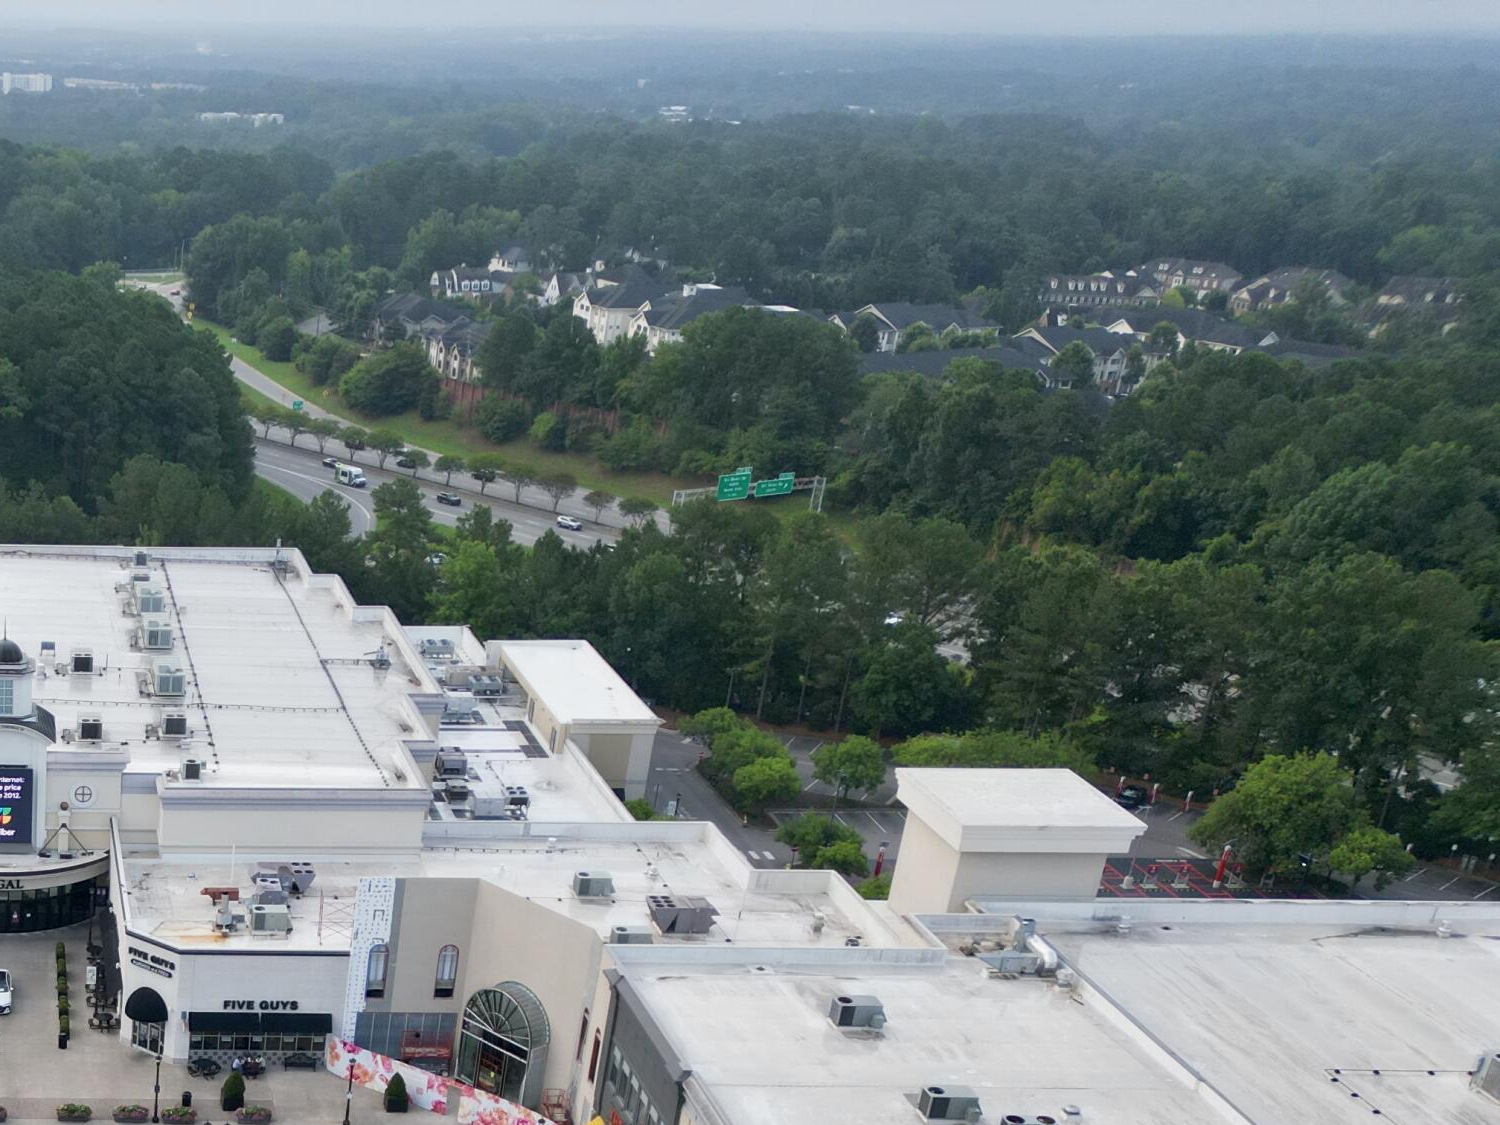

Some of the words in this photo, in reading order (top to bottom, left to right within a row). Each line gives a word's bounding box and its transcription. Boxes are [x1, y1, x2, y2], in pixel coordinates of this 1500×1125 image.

[128, 946, 149, 961] FIVE
[150, 955, 176, 971] GUYS
[223, 1000, 255, 1011] FIVE
[259, 1000, 299, 1011] GUYS
